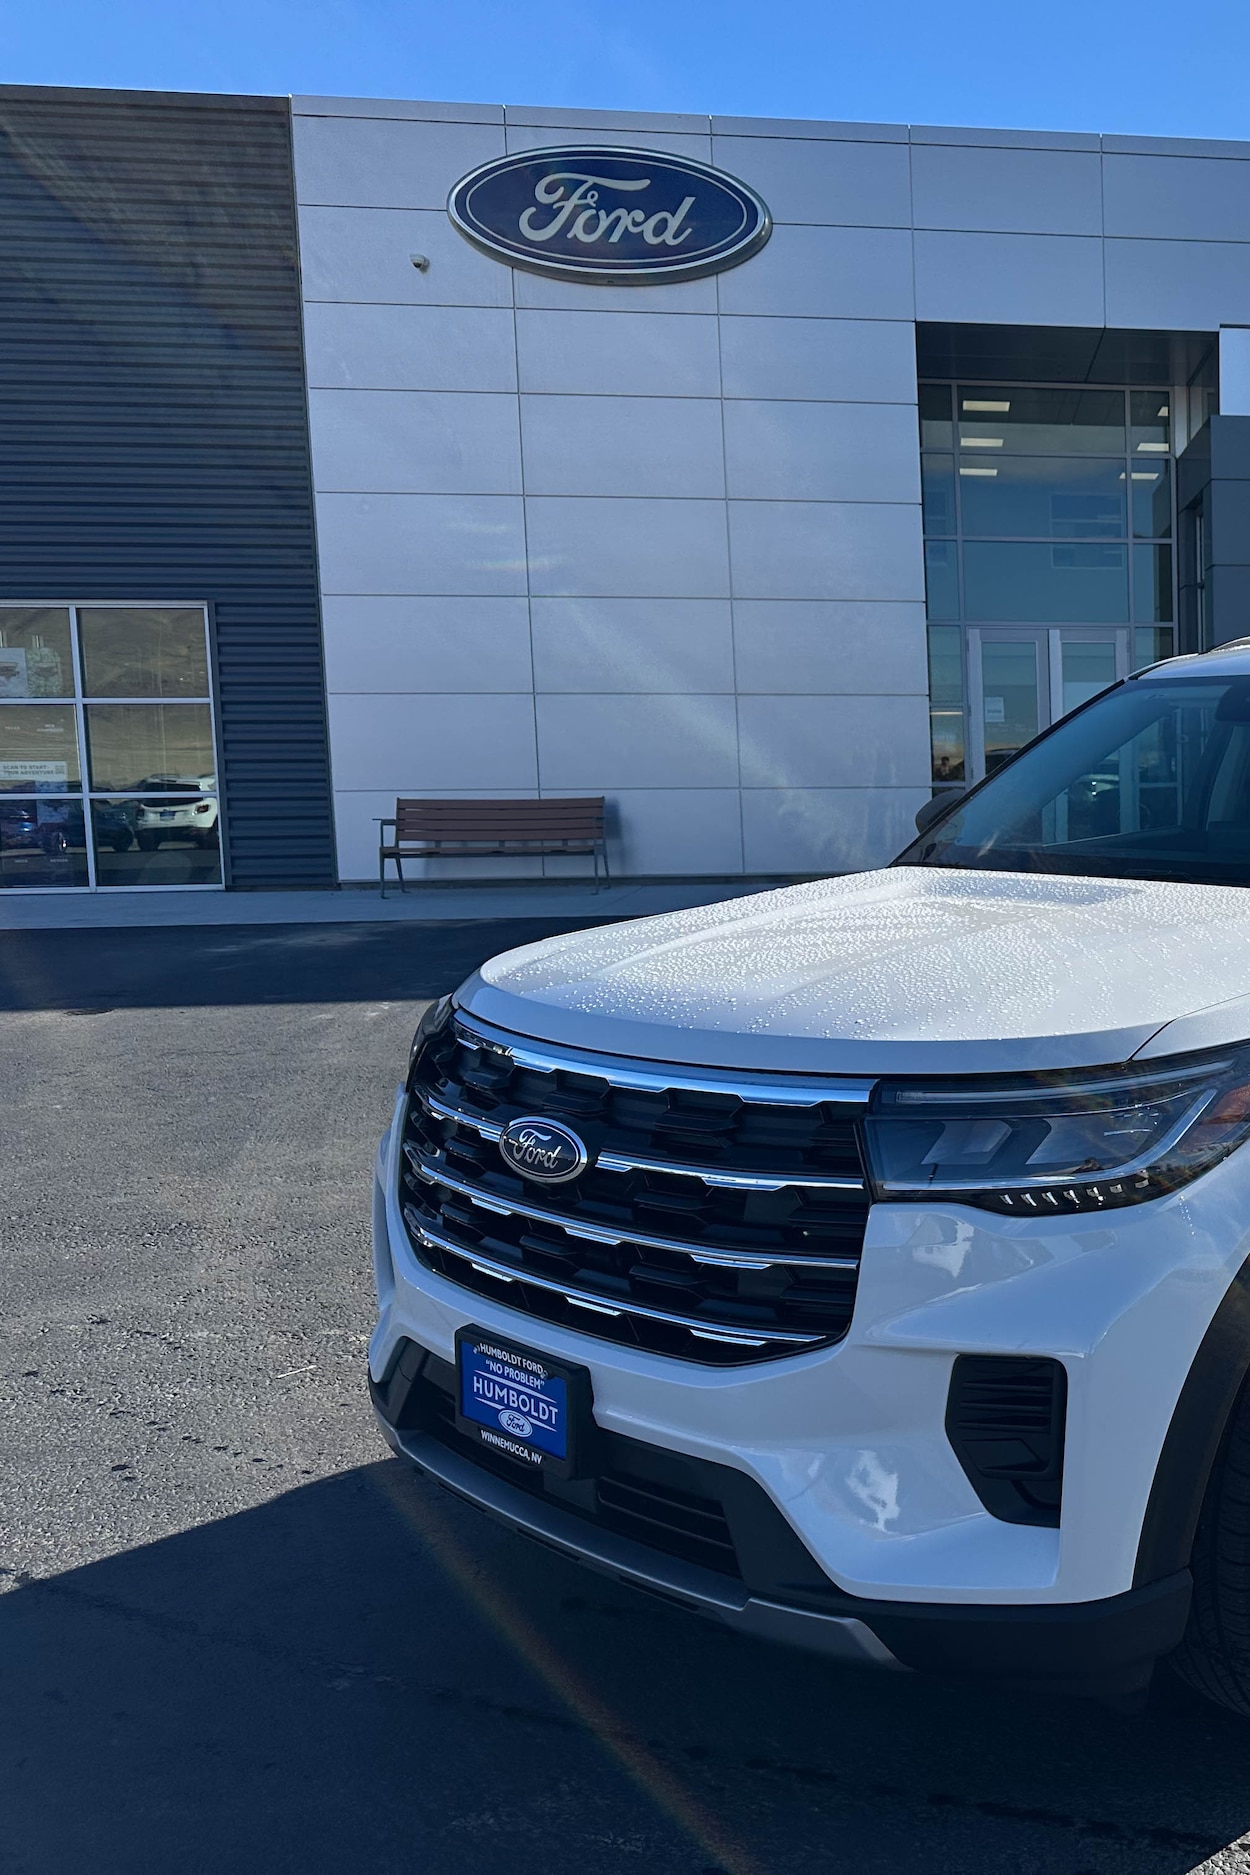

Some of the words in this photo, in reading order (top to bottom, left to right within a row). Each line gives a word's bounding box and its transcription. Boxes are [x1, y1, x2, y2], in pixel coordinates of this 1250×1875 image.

[519, 172, 696, 246] Ford
[513, 1129, 562, 1169] Ford
[479, 1343, 522, 1367] HUMBOLDT
[522, 1358, 544, 1374] FORD
[473, 1376, 559, 1425] HUMBOLDT
[505, 1414, 525, 1433] Ford
[481, 1429, 531, 1461] WINNEMUCCA,
[531, 1453, 543, 1465] NV
